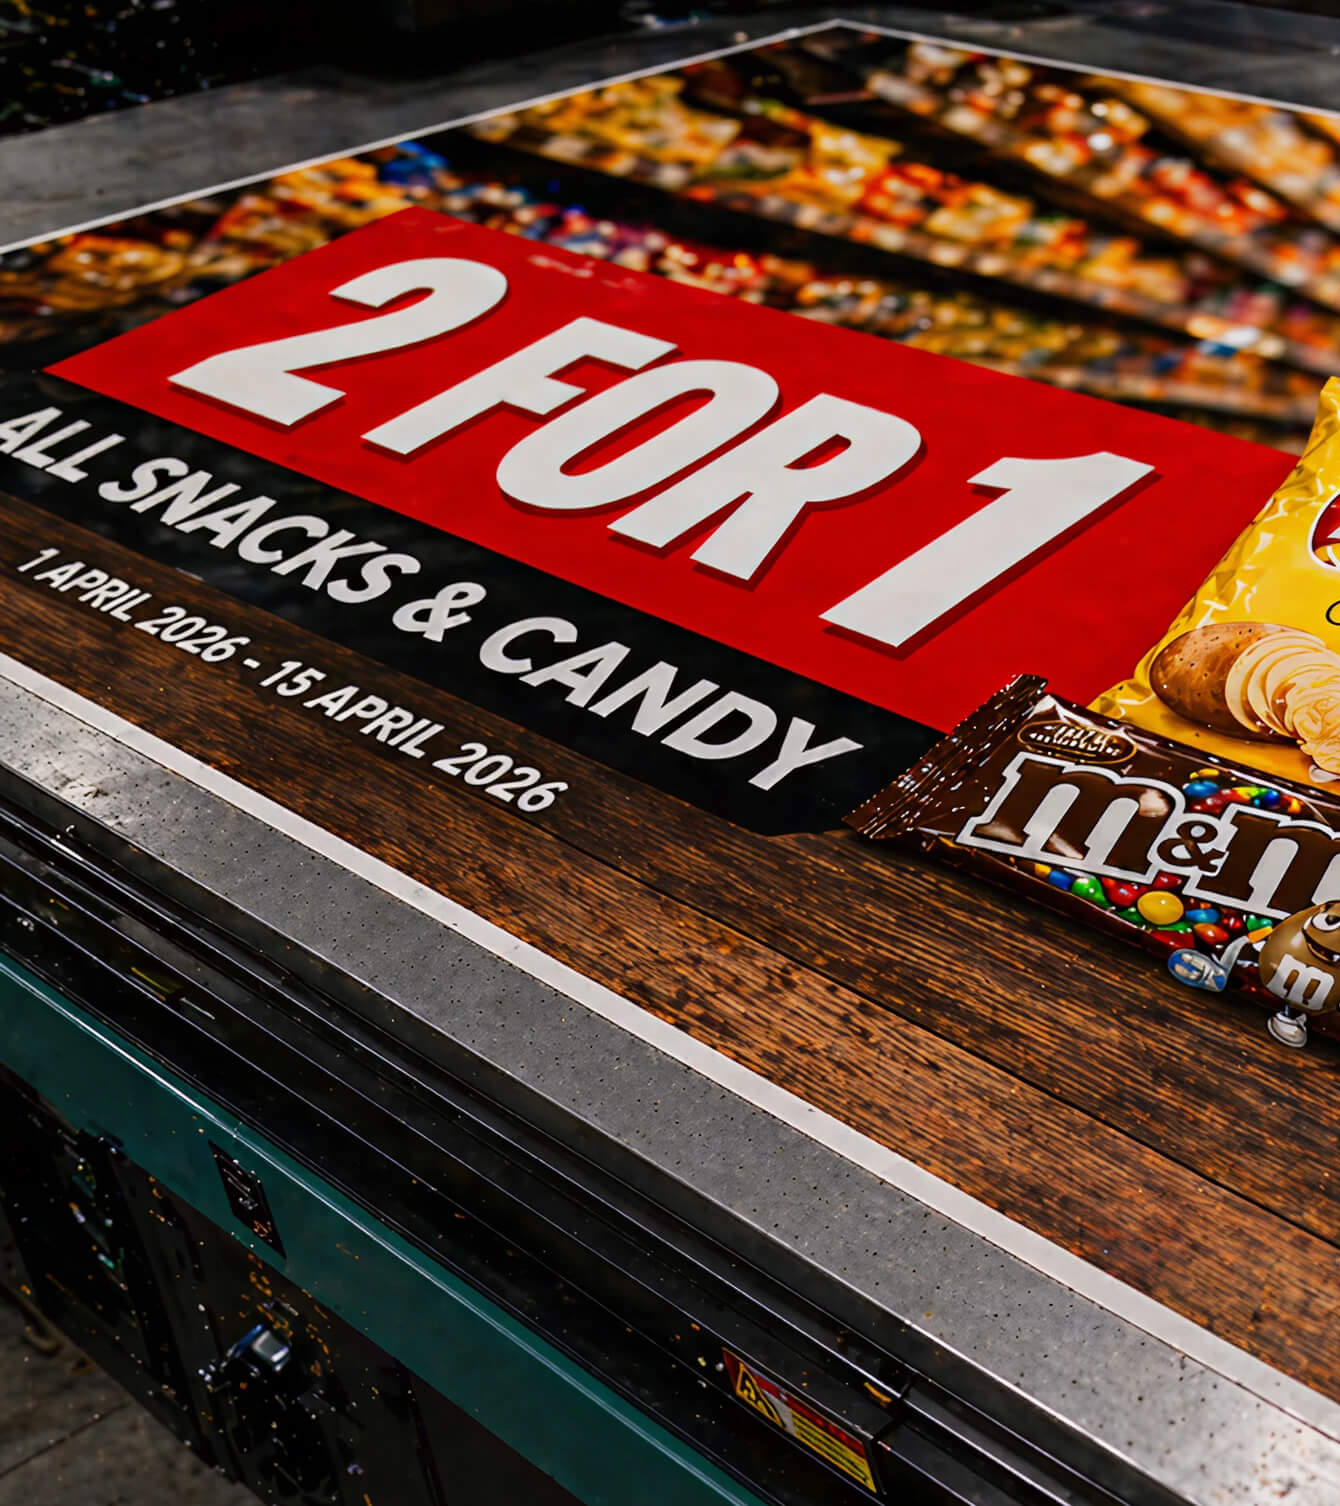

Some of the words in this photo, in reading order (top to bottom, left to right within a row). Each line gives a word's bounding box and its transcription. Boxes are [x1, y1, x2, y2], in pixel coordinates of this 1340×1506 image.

[167, 257, 507, 426] 2
[361, 316, 921, 581] FOR
[820, 451, 1156, 648] 1
[17, 547, 61, 572] 1
[0, 407, 126, 483] ALL
[98, 457, 421, 603] SNACKS
[392, 582, 486, 644] &
[479, 617, 864, 790] CANDY
[34, 561, 152, 622] APRIL
[134, 606, 251, 662] 2026
[242, 657, 261, 669] -
[259, 660, 327, 697] 15
[303, 685, 445, 759] APRIL
[432, 742, 569, 812] 2026
